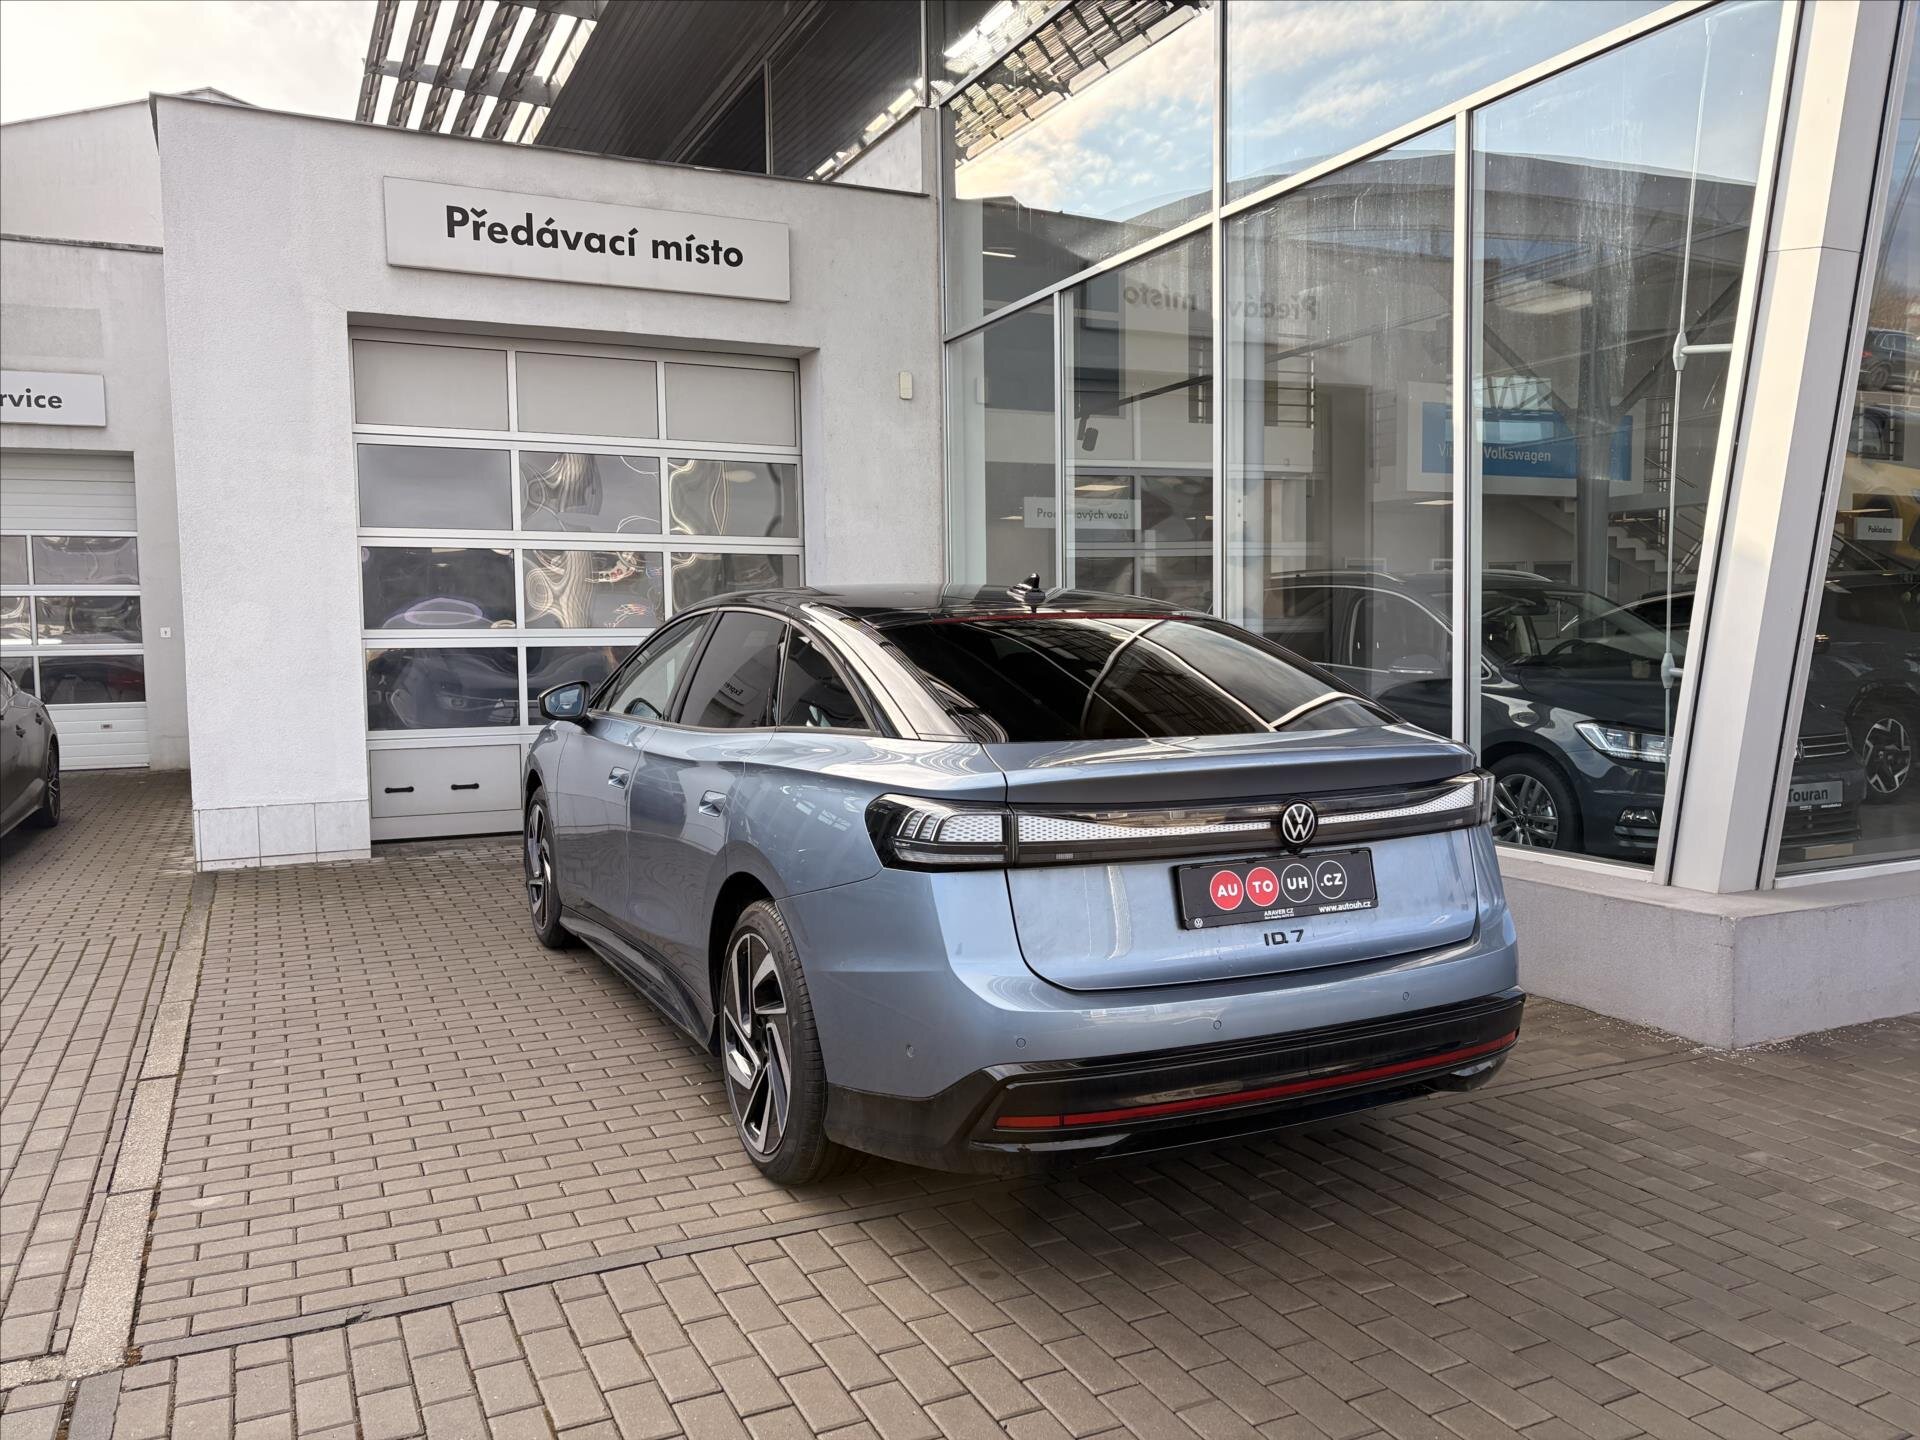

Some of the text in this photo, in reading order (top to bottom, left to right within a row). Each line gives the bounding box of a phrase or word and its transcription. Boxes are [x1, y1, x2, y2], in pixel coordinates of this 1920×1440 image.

[445, 204, 744, 268] Předávací místo
[0, 387, 63, 409] rvice
[1483, 446, 1551, 464] Volkswagen
[1076, 508, 1104, 521] ových
[1789, 788, 1829, 802] Touran
[1318, 900, 1371, 913] www.autouh.cz
